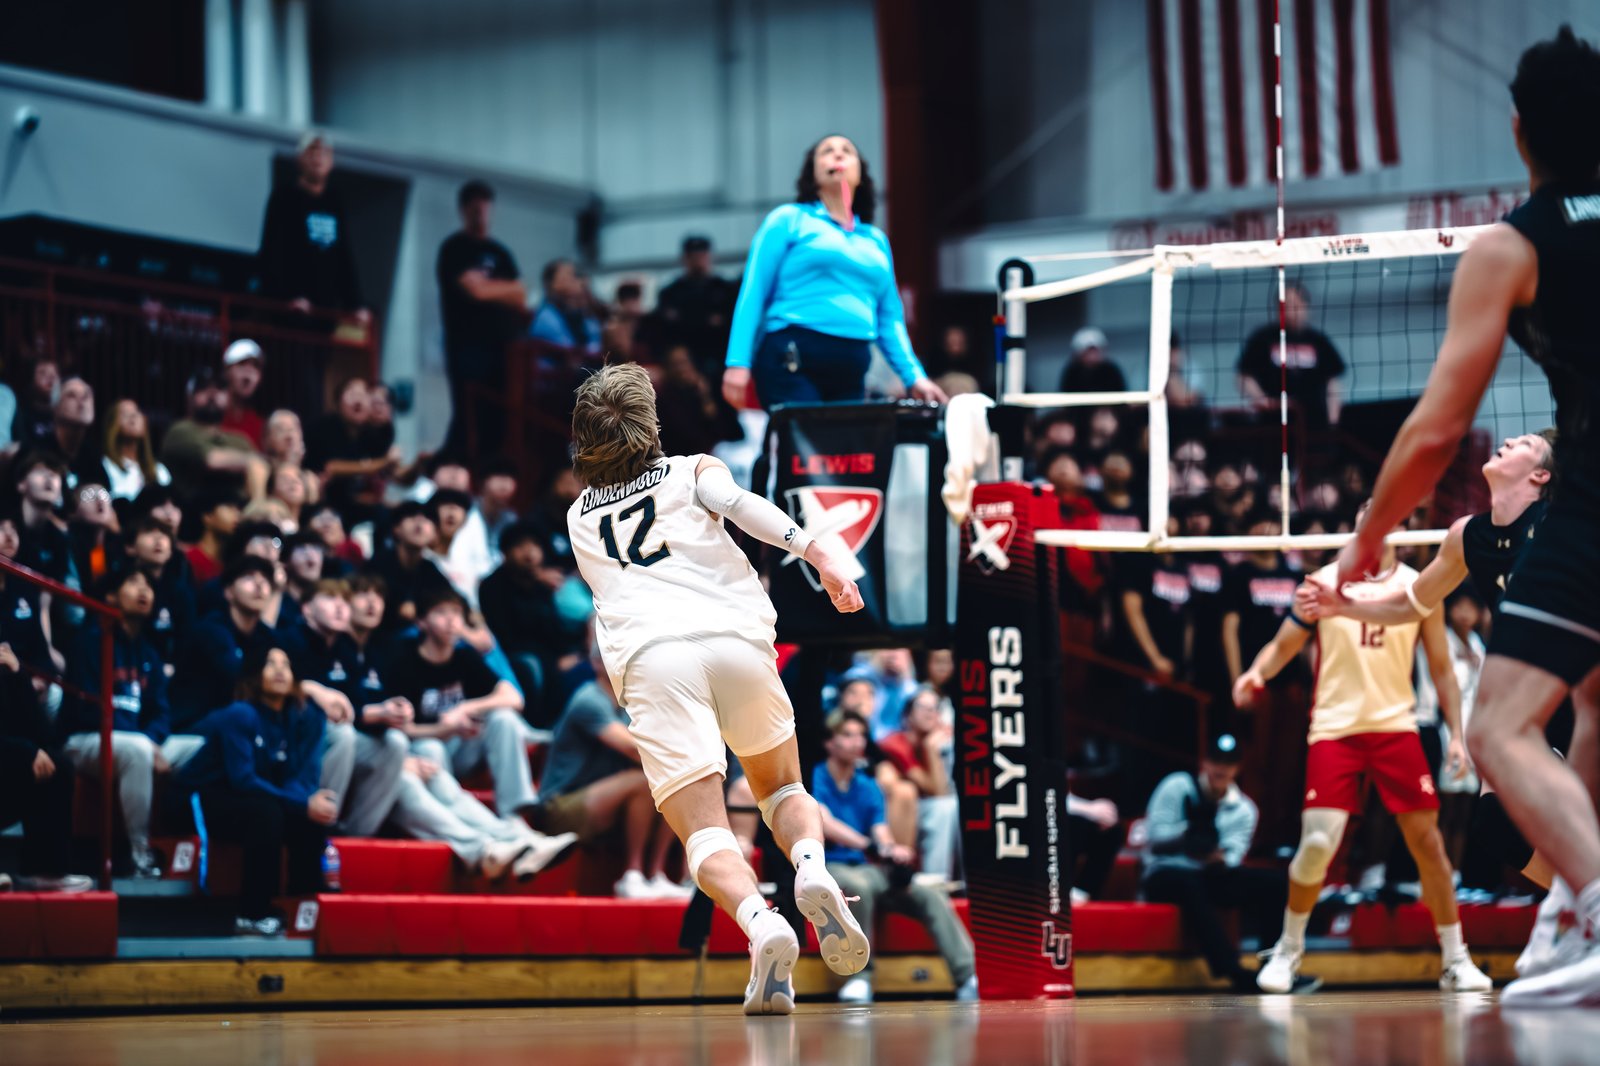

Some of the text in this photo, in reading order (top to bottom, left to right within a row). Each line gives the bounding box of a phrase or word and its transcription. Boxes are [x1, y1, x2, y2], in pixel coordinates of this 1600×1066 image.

[791, 453, 876, 475] LEWIS
[599, 494, 672, 571] 12
[961, 659, 992, 831] LEWIS
[988, 626, 1029, 860] FLYERS
[1041, 921, 1072, 970] LU
